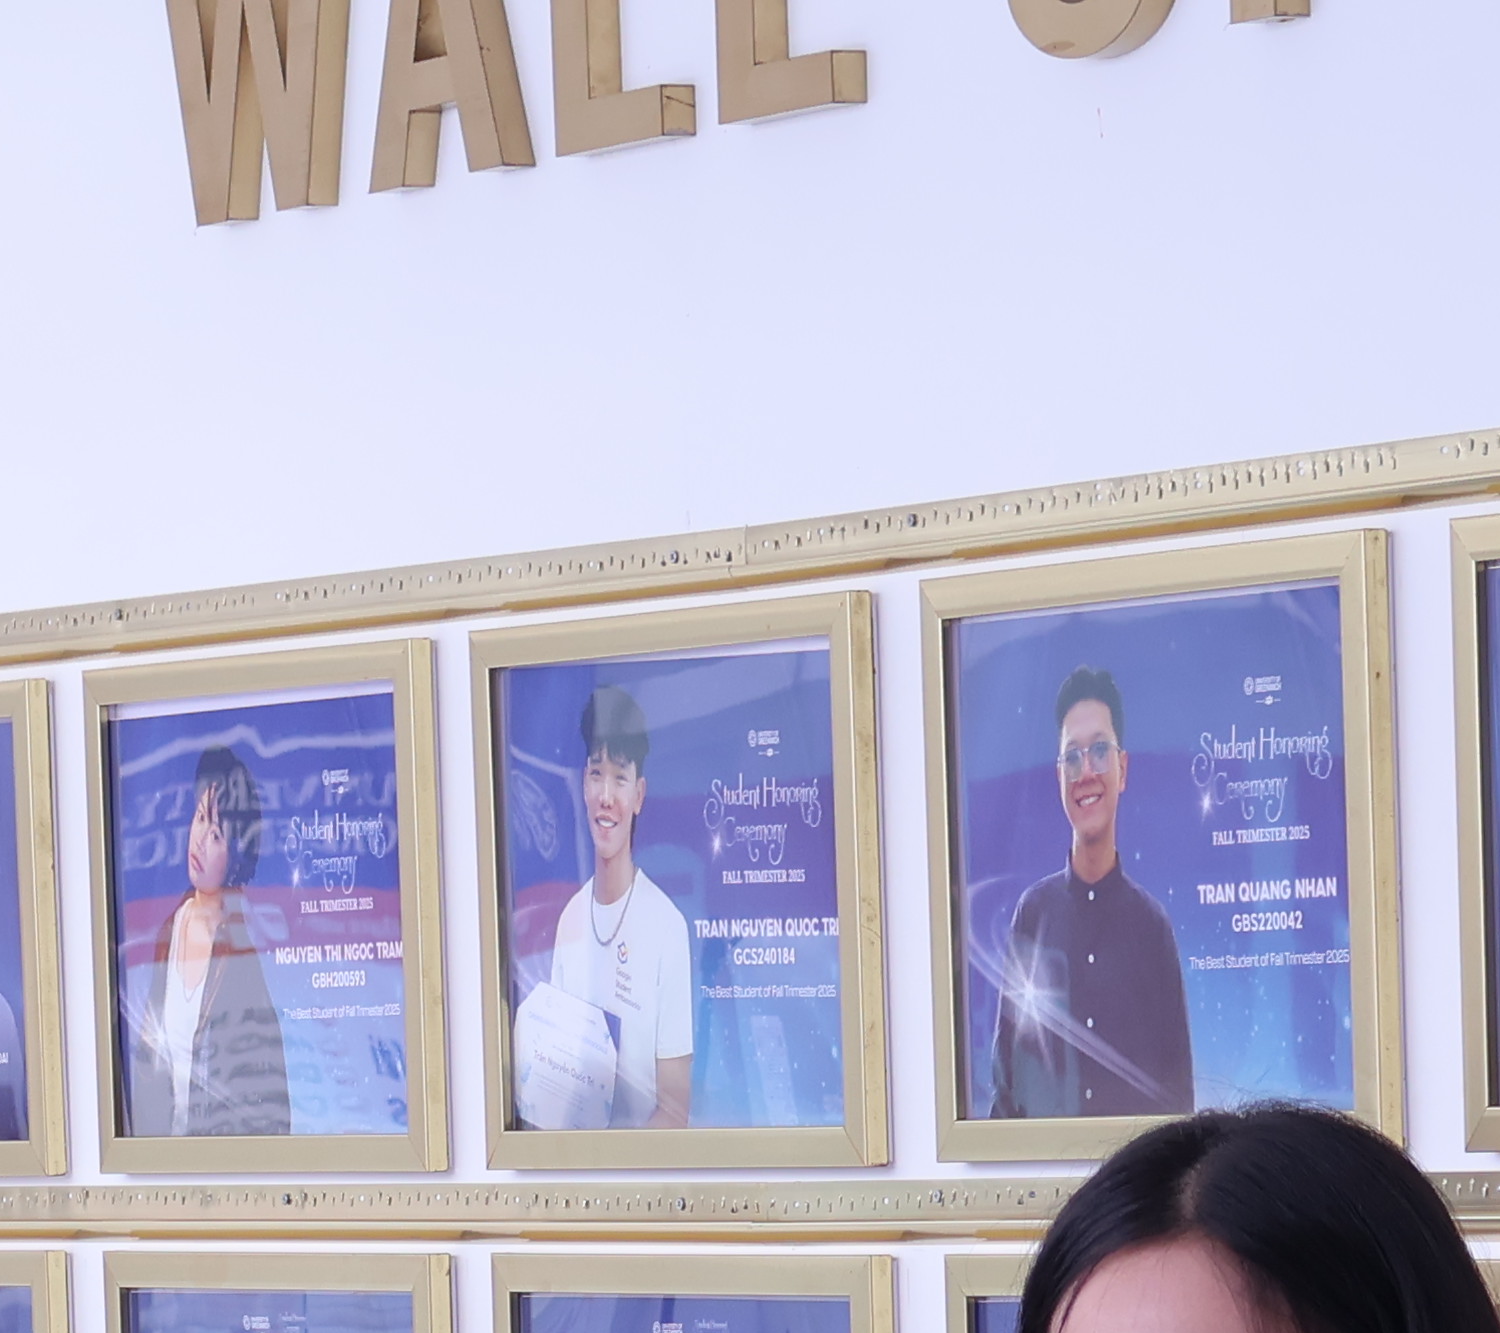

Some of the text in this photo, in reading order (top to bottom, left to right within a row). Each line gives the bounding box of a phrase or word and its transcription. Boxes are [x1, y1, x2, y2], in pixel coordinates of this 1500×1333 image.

[1212, 826, 1310, 845] FALL TRIMESTER 2025
[723, 869, 805, 884] FALL TRIMESTER 2025
[1197, 877, 1337, 904] TRAN QUANG NHAN
[694, 919, 728, 938] TRAN
[732, 919, 782, 937] NGUYEN
[786, 918, 819, 936] QUOC
[1232, 911, 1303, 932] GBS220042
[276, 946, 322, 964] NGUYEN
[325, 944, 341, 962] THI
[344, 943, 373, 961] NGOC
[734, 948, 795, 965] GCS240184
[1189, 949, 1349, 970] The Best Student of Fall Trimester 2025
[312, 971, 366, 988] GBH200593
